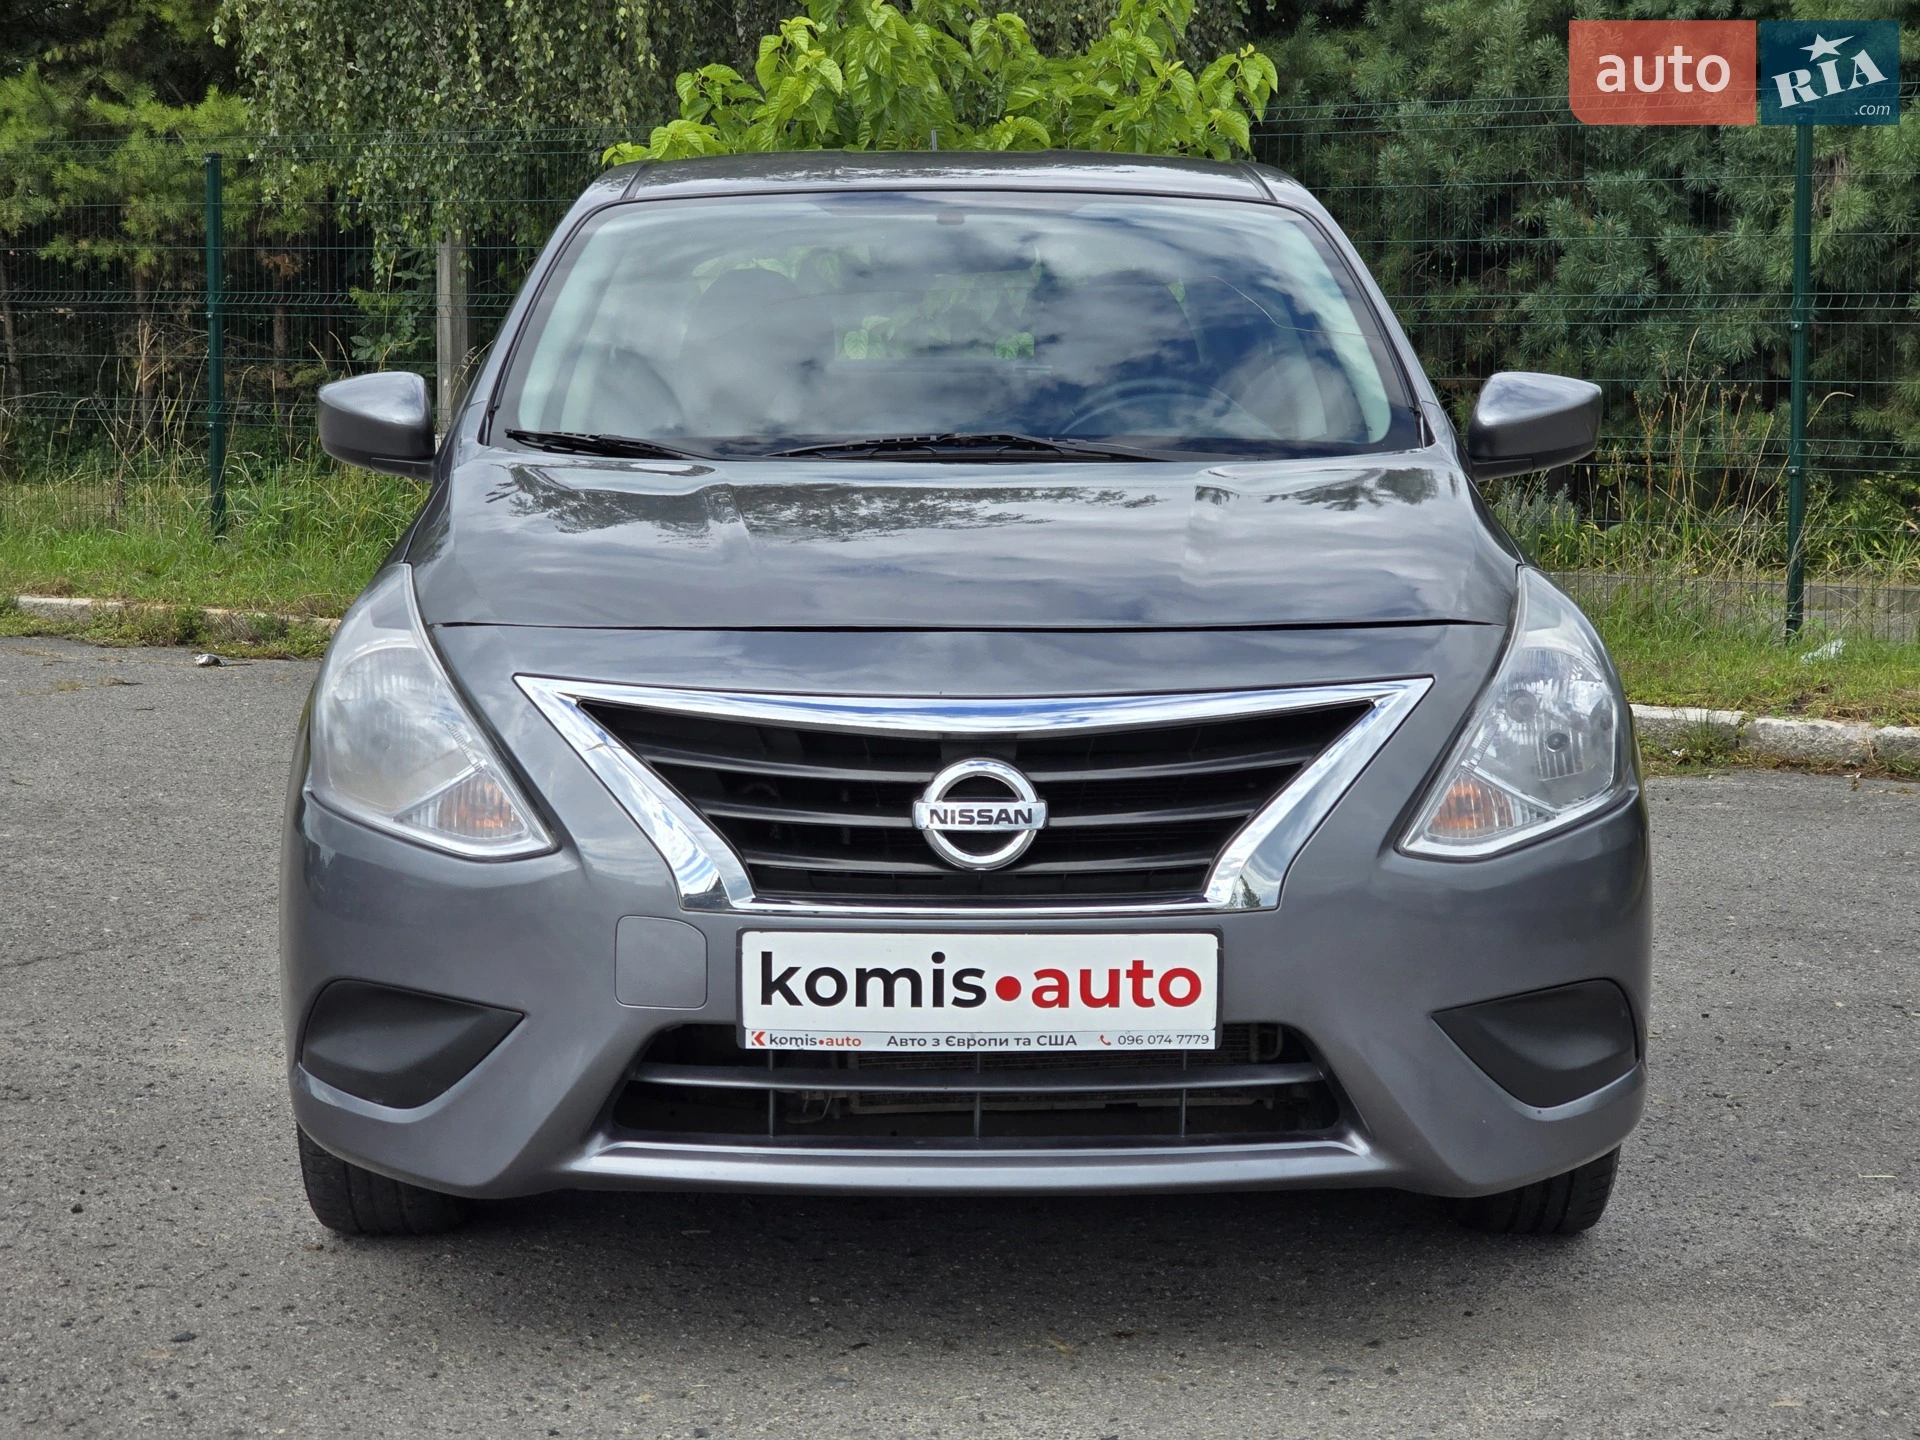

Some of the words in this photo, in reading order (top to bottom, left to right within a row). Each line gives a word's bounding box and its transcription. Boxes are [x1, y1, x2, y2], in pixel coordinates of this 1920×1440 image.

[929, 808, 1033, 825] NISSAN
[886, 1035, 927, 1047] Авто
[932, 1037, 940, 1047] з
[945, 1035, 1009, 1050] Європи
[1014, 1037, 1031, 1047] та
[1036, 1034, 1077, 1047] США
[1117, 1034, 1144, 1046] 096
[1147, 1034, 1173, 1045] 074
[1176, 1034, 1209, 1045] 7779
